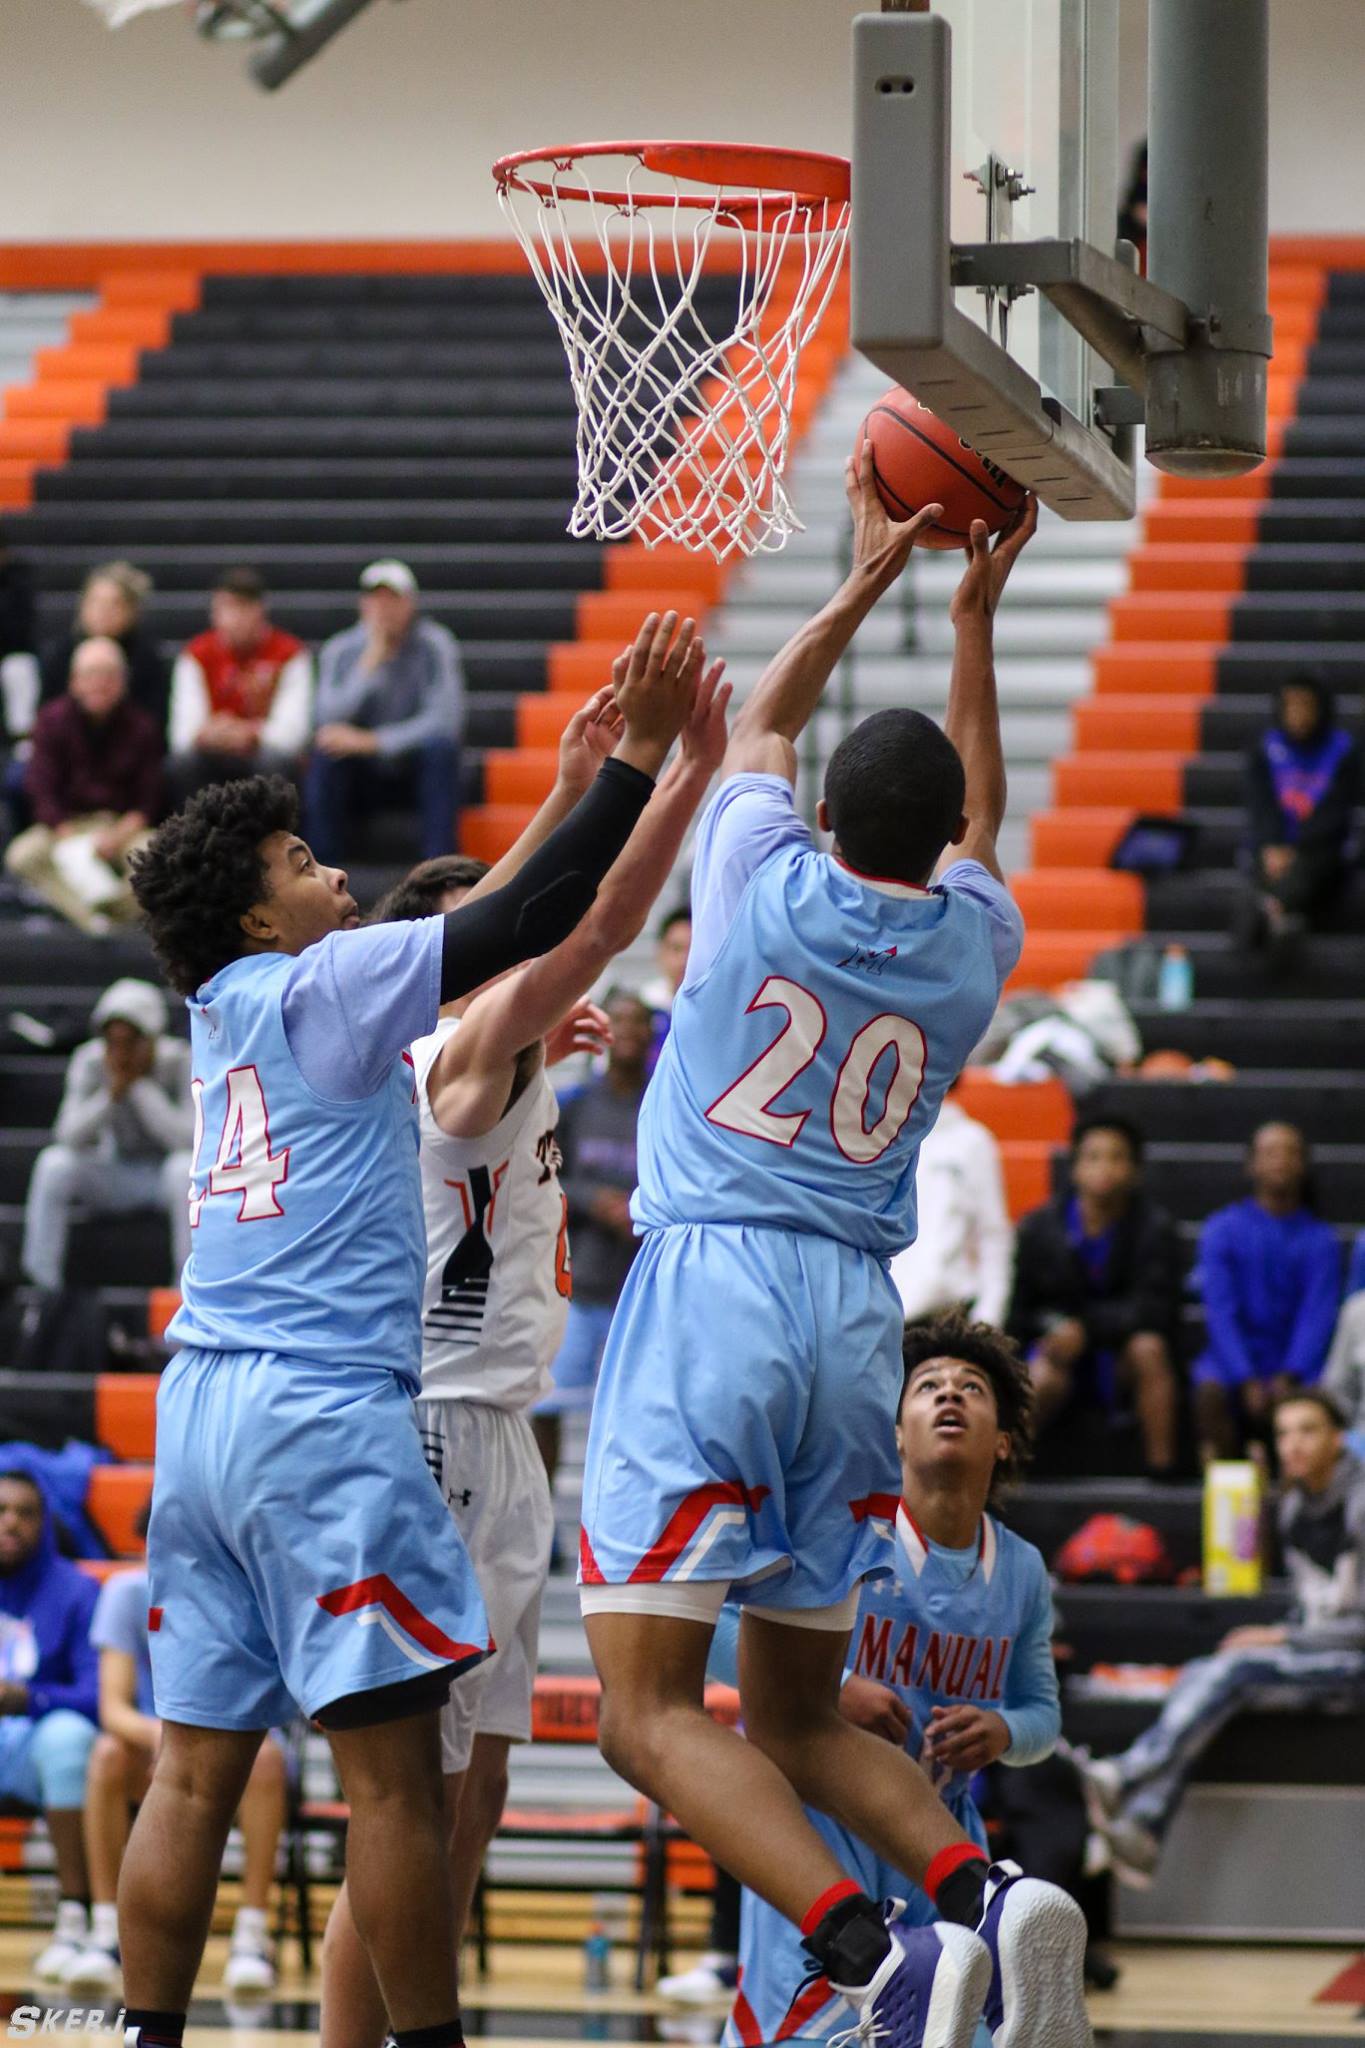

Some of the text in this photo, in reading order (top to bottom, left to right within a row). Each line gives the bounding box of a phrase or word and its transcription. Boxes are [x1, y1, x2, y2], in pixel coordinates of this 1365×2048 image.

[188, 1064, 292, 1229] 4
[704, 975, 928, 1164] 20
[853, 1613, 1011, 1701] MANUAL
